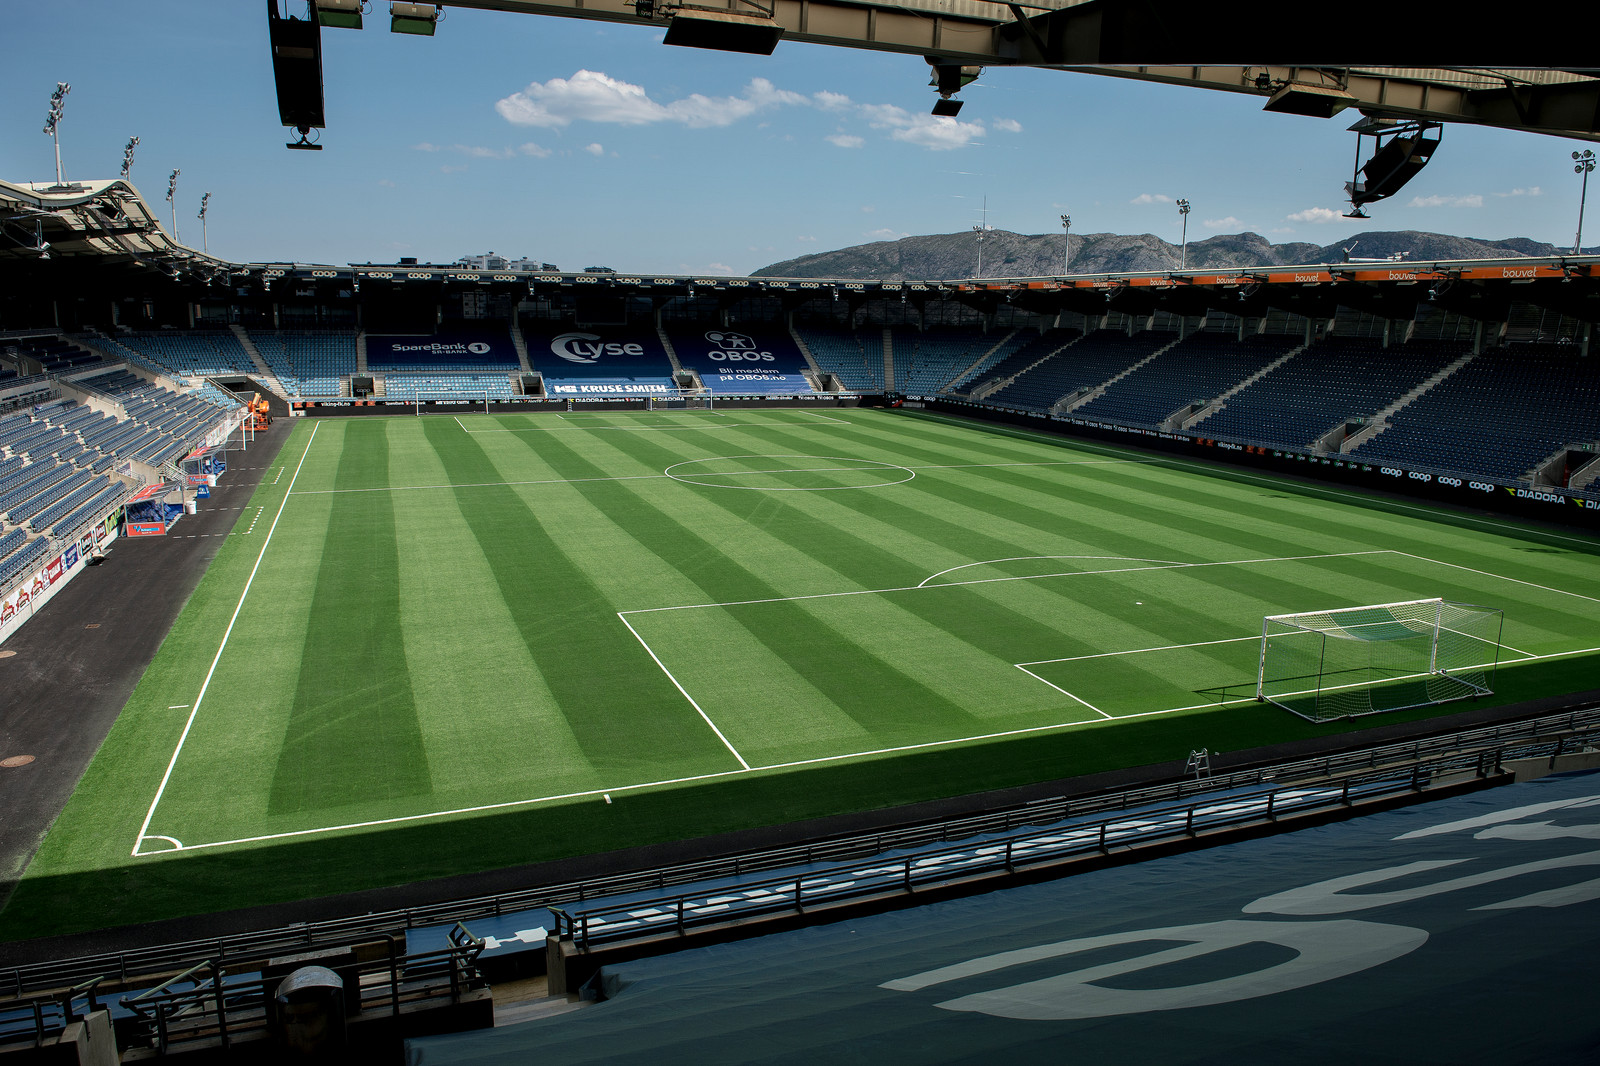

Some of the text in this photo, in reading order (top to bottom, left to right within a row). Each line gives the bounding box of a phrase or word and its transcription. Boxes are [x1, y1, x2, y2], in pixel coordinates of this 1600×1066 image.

[1295, 272, 1319, 282] bouvet
[1388, 270, 1417, 280] bouvet
[1502, 265, 1538, 278] bouvet
[392, 343, 466, 352] SpareBank
[571, 341, 644, 359] Lyse
[708, 351, 775, 361] OBOS
[580, 384, 622, 393] KRUSE
[624, 384, 667, 393] SMITH
[1380, 466, 1403, 478] coop
[1408, 471, 1432, 482] coop
[1437, 475, 1462, 487] coop
[1468, 481, 1495, 493] coop
[1516, 488, 1566, 504] DIADORA
